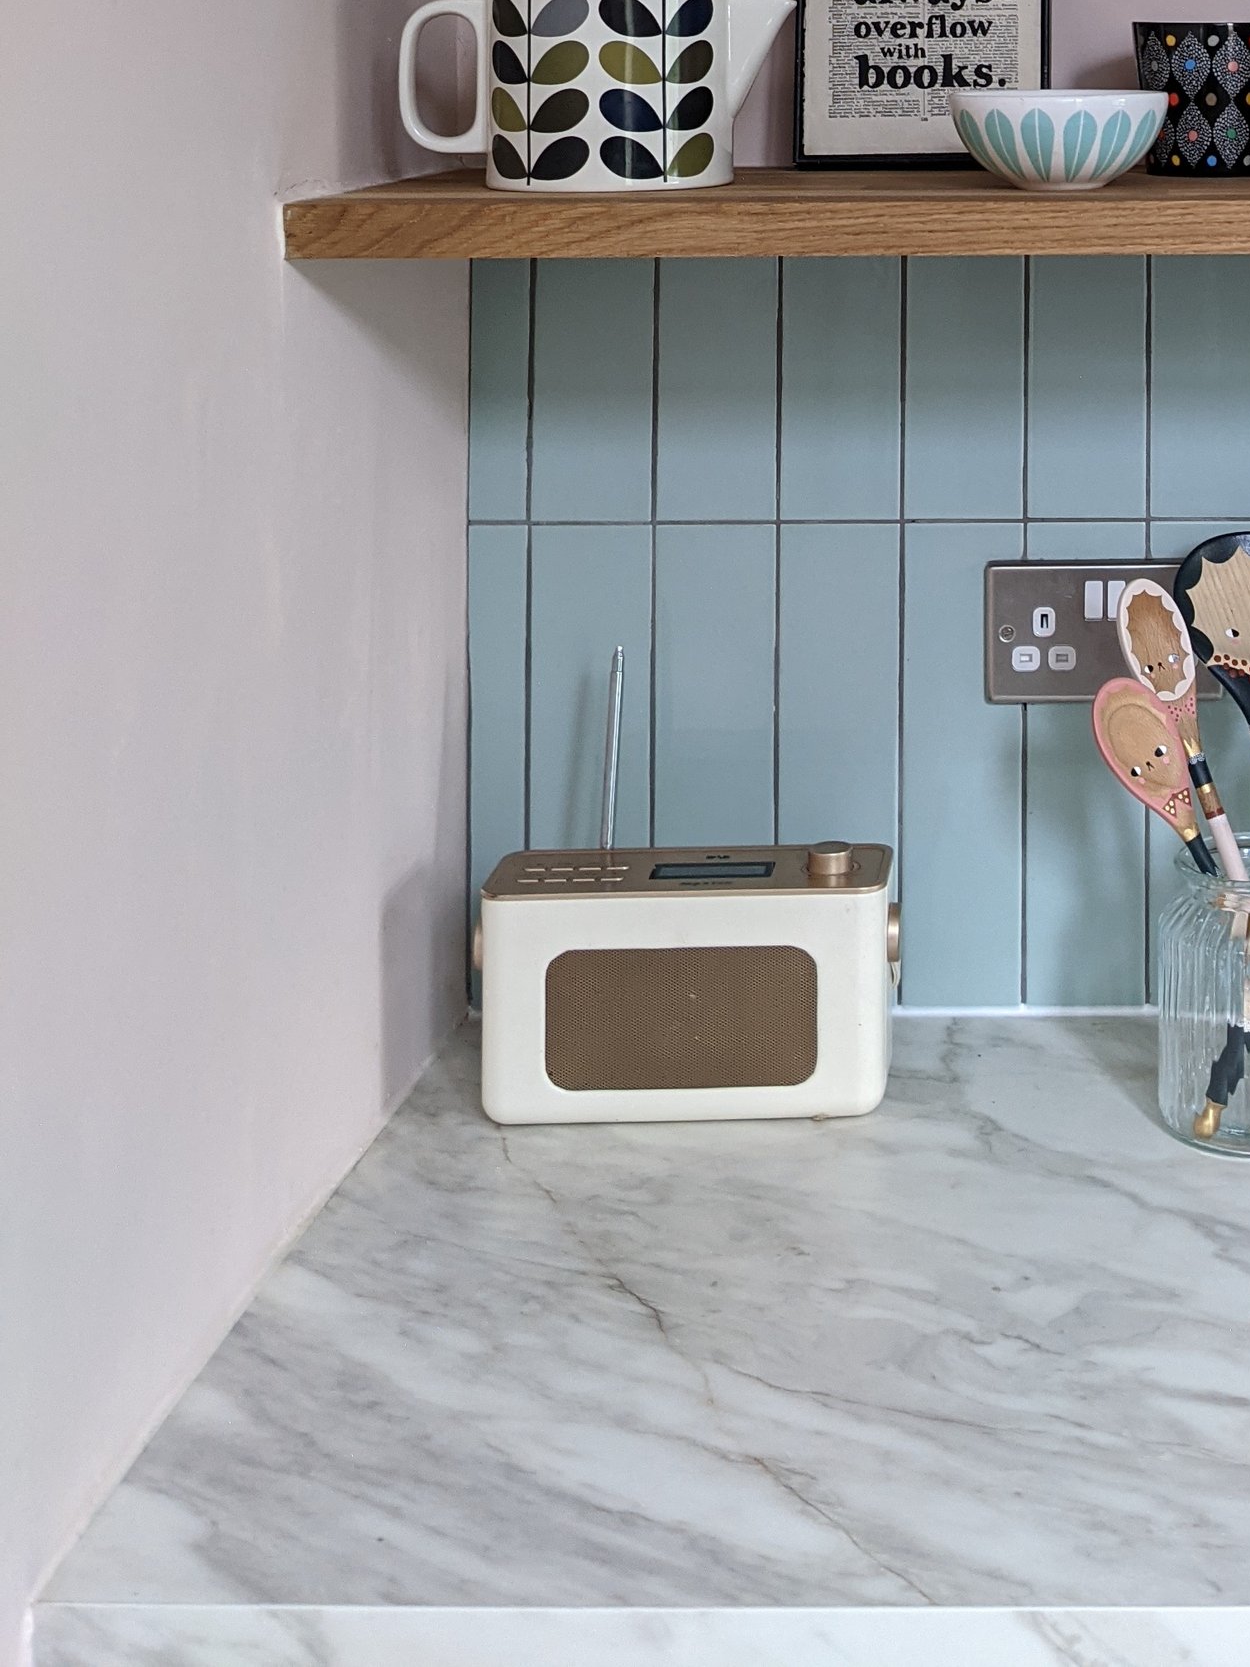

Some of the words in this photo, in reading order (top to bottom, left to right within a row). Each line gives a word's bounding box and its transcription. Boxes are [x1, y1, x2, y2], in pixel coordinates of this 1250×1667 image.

[853, 14, 994, 39] overflow
[879, 43, 927, 60] with
[853, 54, 1007, 90] books.
